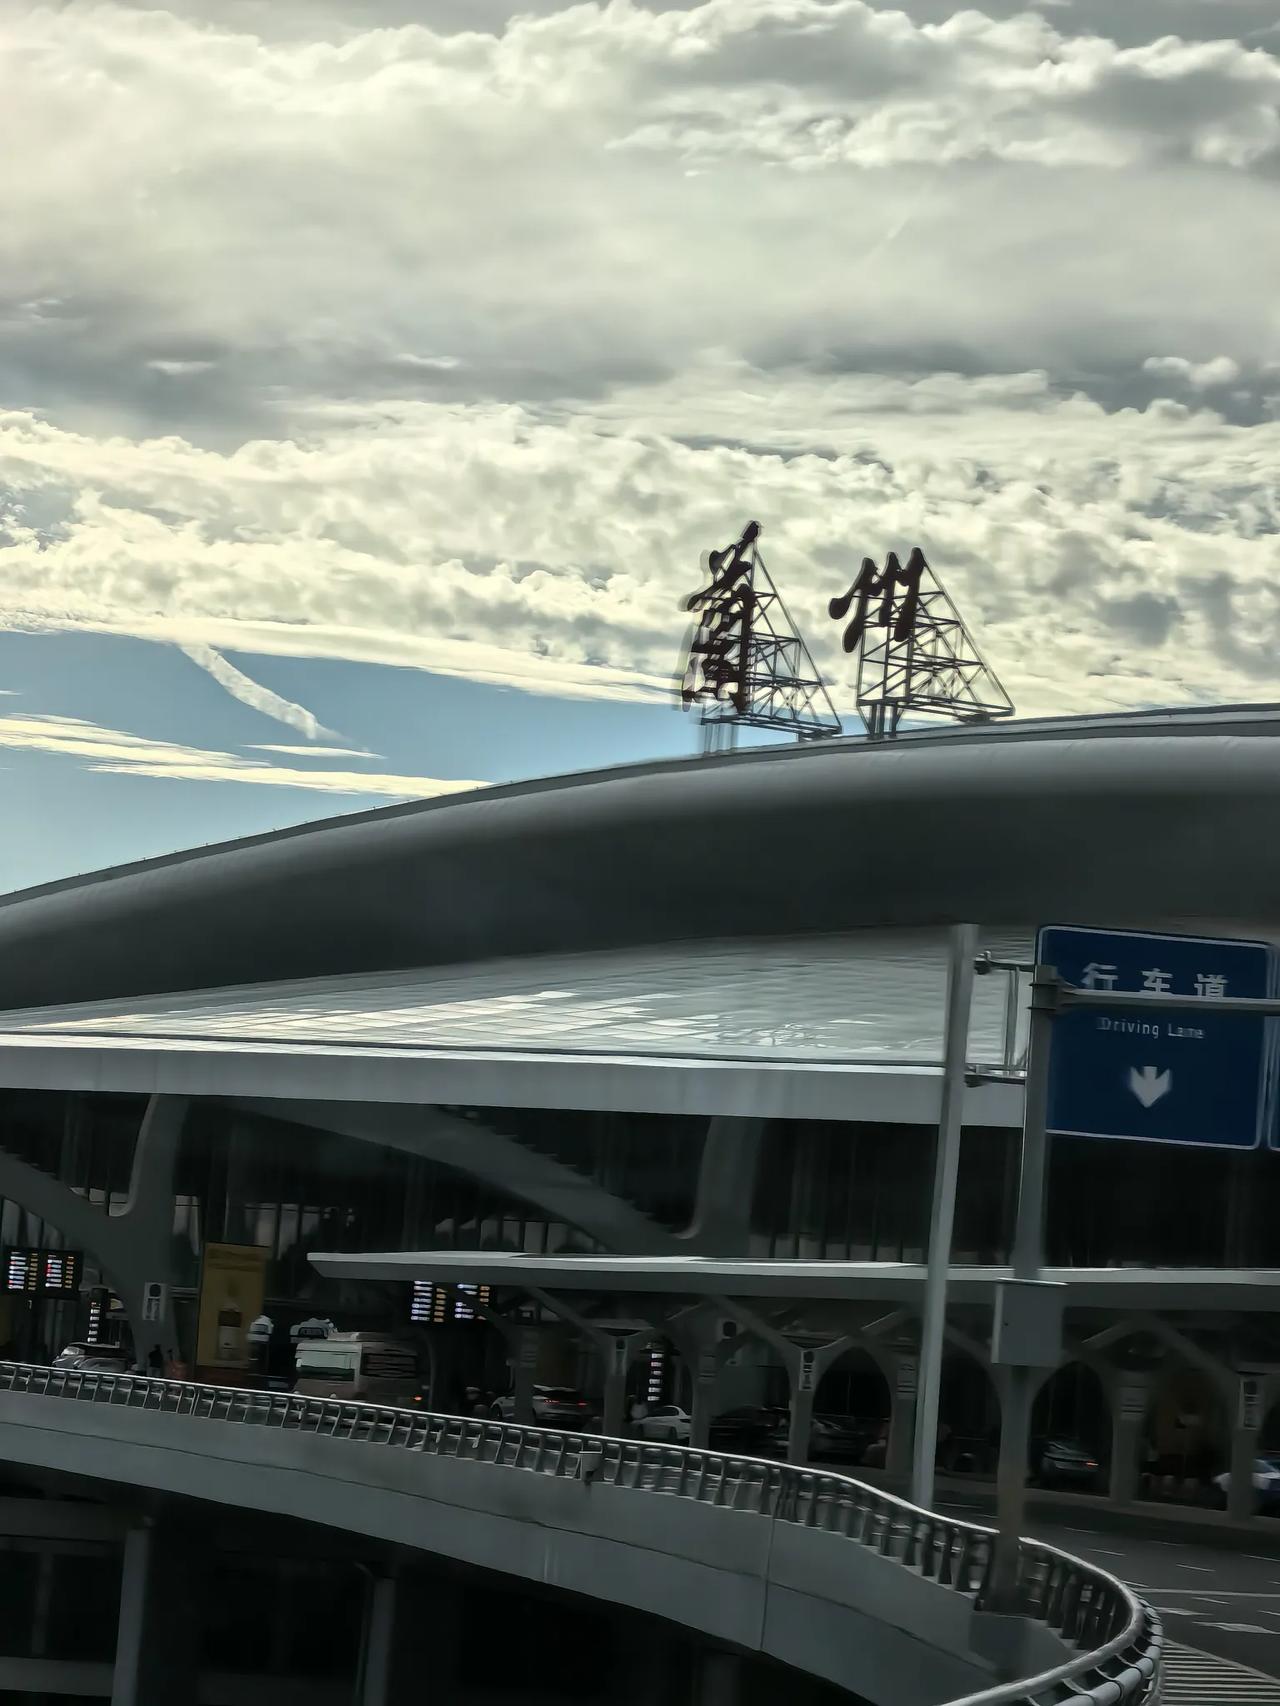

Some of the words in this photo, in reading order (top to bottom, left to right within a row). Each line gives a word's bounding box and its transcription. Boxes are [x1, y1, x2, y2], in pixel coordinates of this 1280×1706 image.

[1081, 962, 1228, 998] 行车道
[1097, 1016, 1160, 1039] Driving
[1167, 1023, 1205, 1040] Lane
